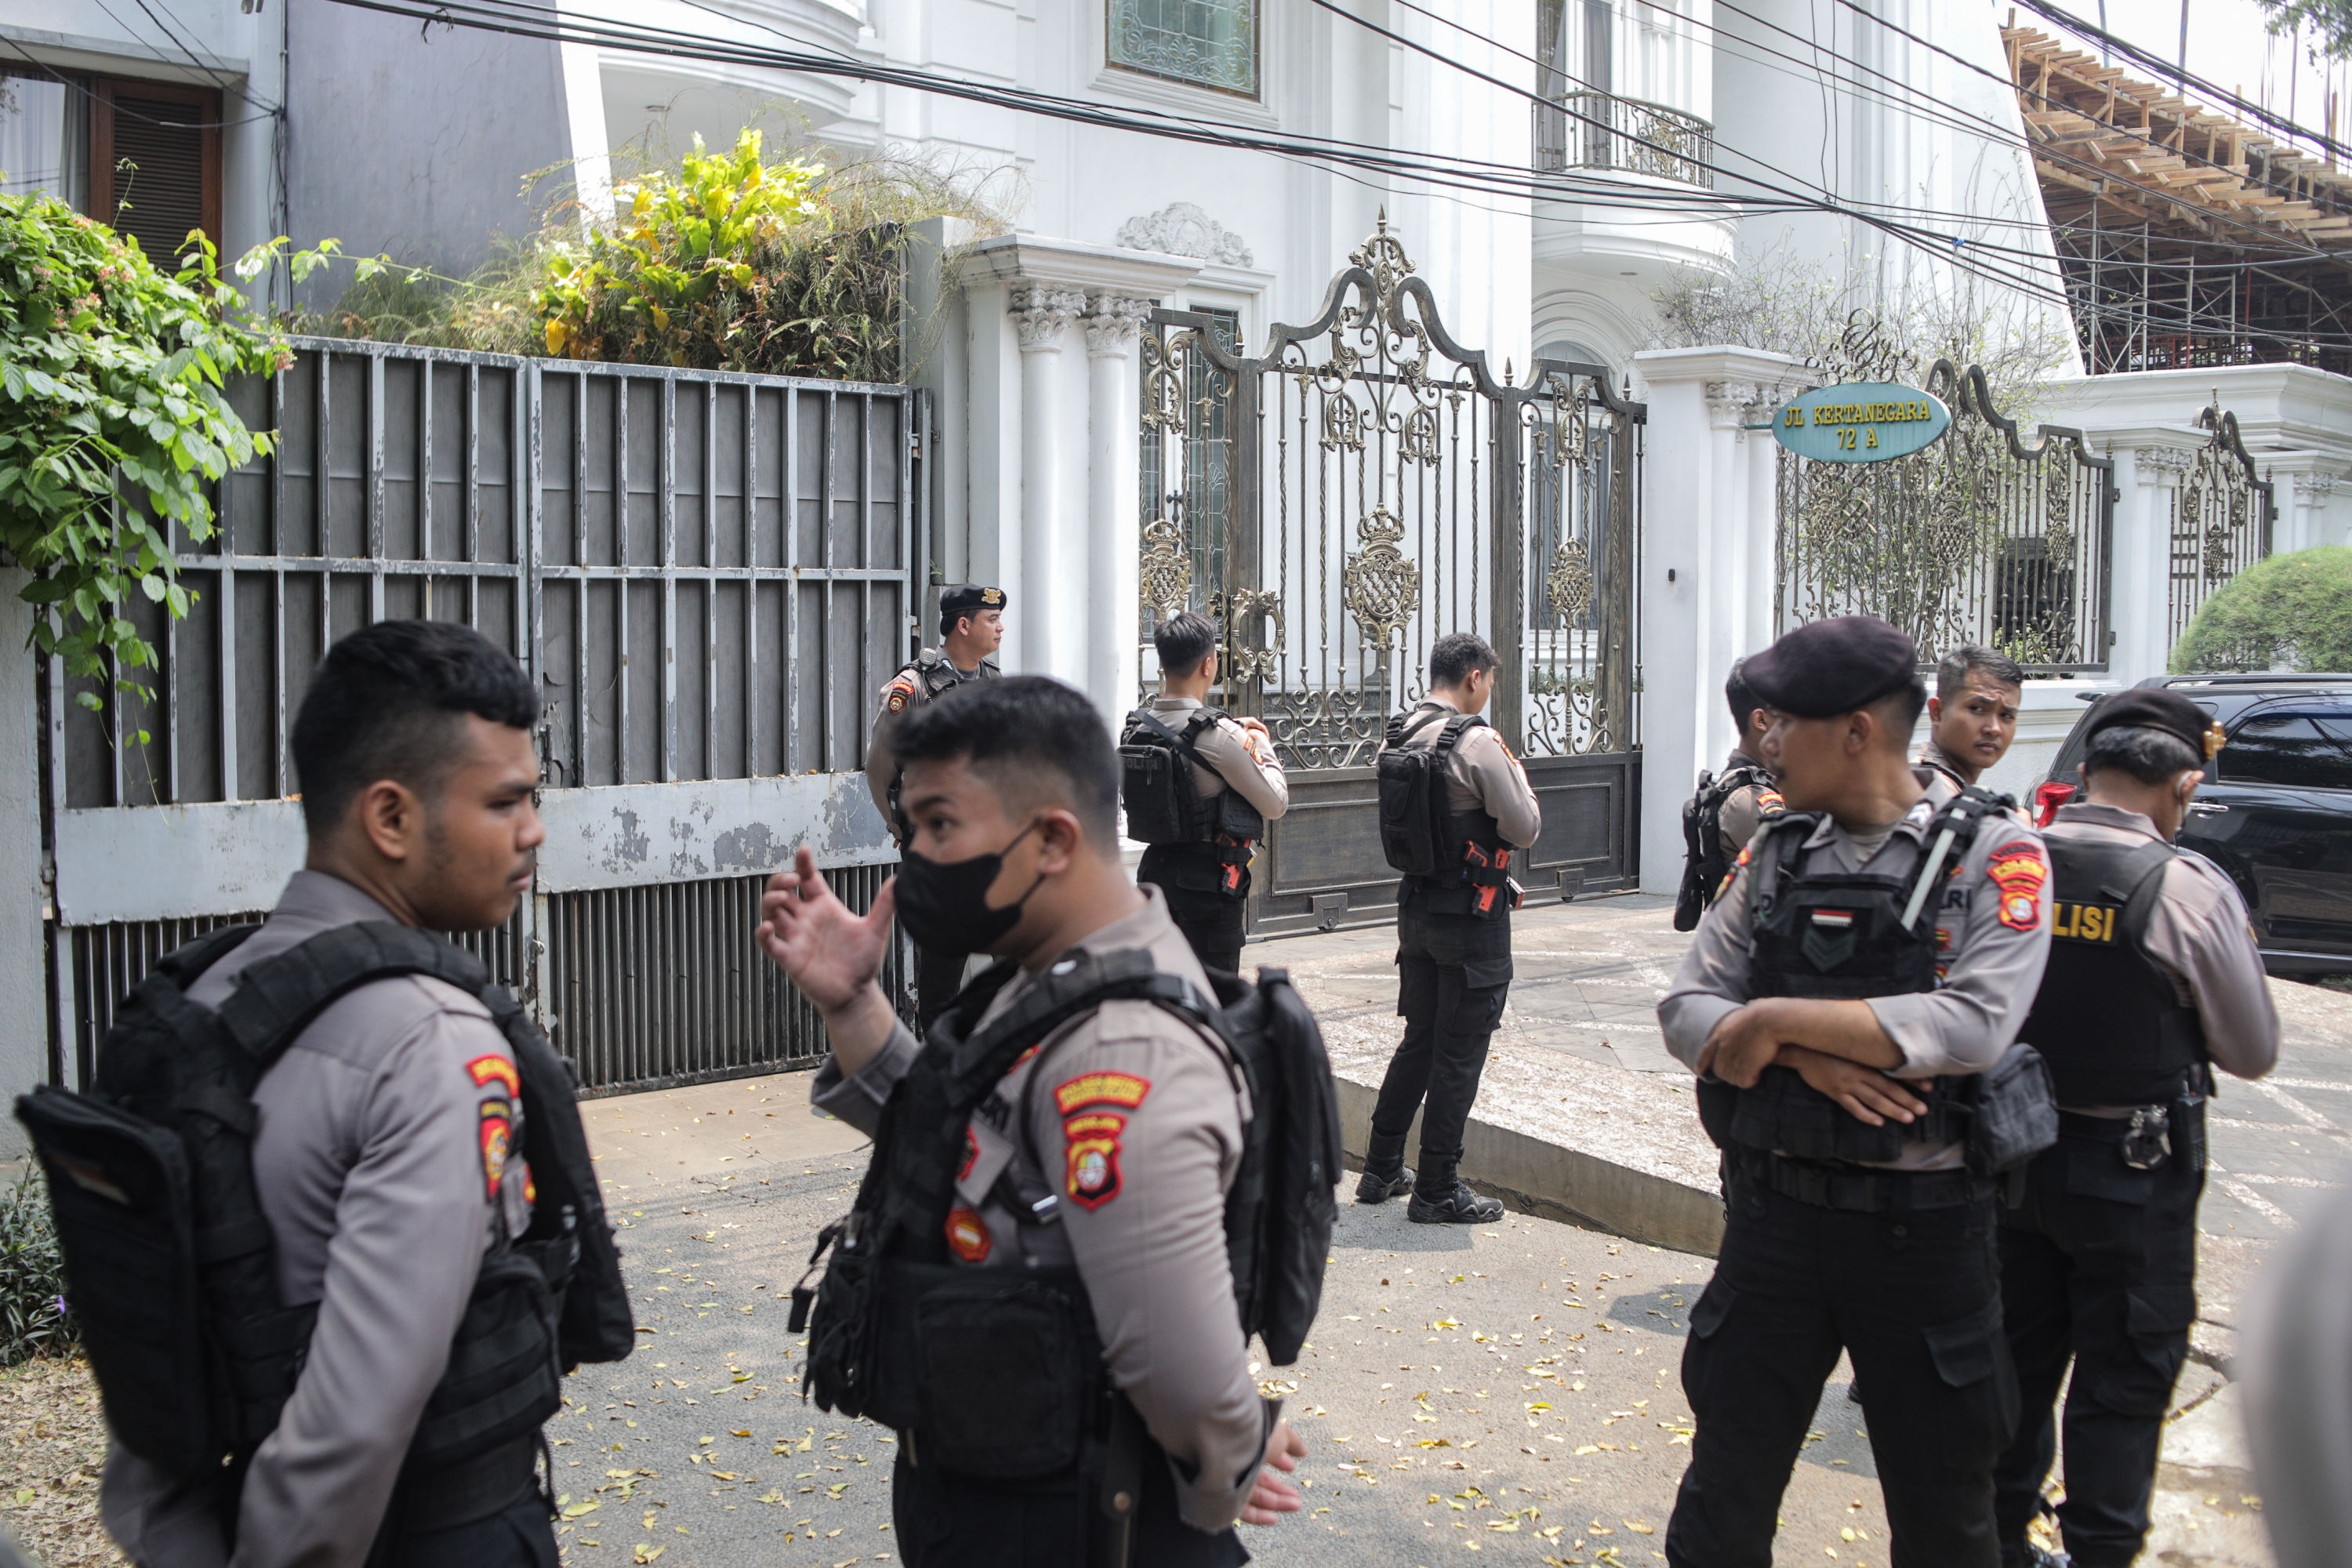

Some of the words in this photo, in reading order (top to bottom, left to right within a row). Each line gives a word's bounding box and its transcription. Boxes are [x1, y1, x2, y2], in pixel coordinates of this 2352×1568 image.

[1784, 406, 1804, 426] JL
[1813, 400, 1931, 426] KERTANEGARA
[1836, 427, 1857, 449] 72
[1865, 427, 1878, 448] A
[2052, 902, 2115, 942] LISI
